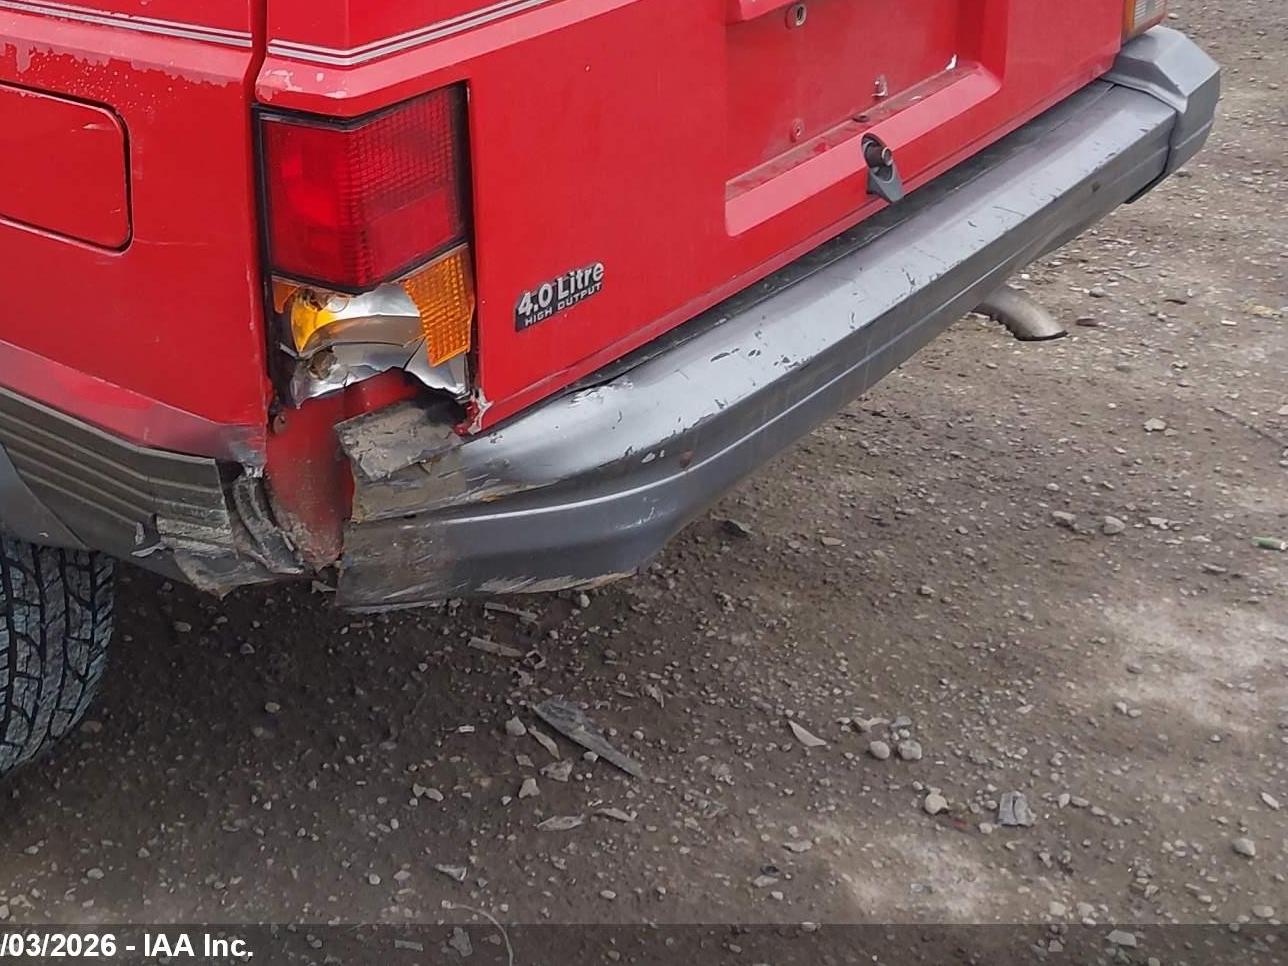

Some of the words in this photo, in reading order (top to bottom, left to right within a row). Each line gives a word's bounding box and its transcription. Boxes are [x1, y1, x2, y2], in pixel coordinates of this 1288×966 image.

[518, 283, 553, 316] 4.0
[557, 262, 605, 301] Litre
[524, 307, 553, 327] HIGH
[557, 281, 603, 311] OUTPUT
